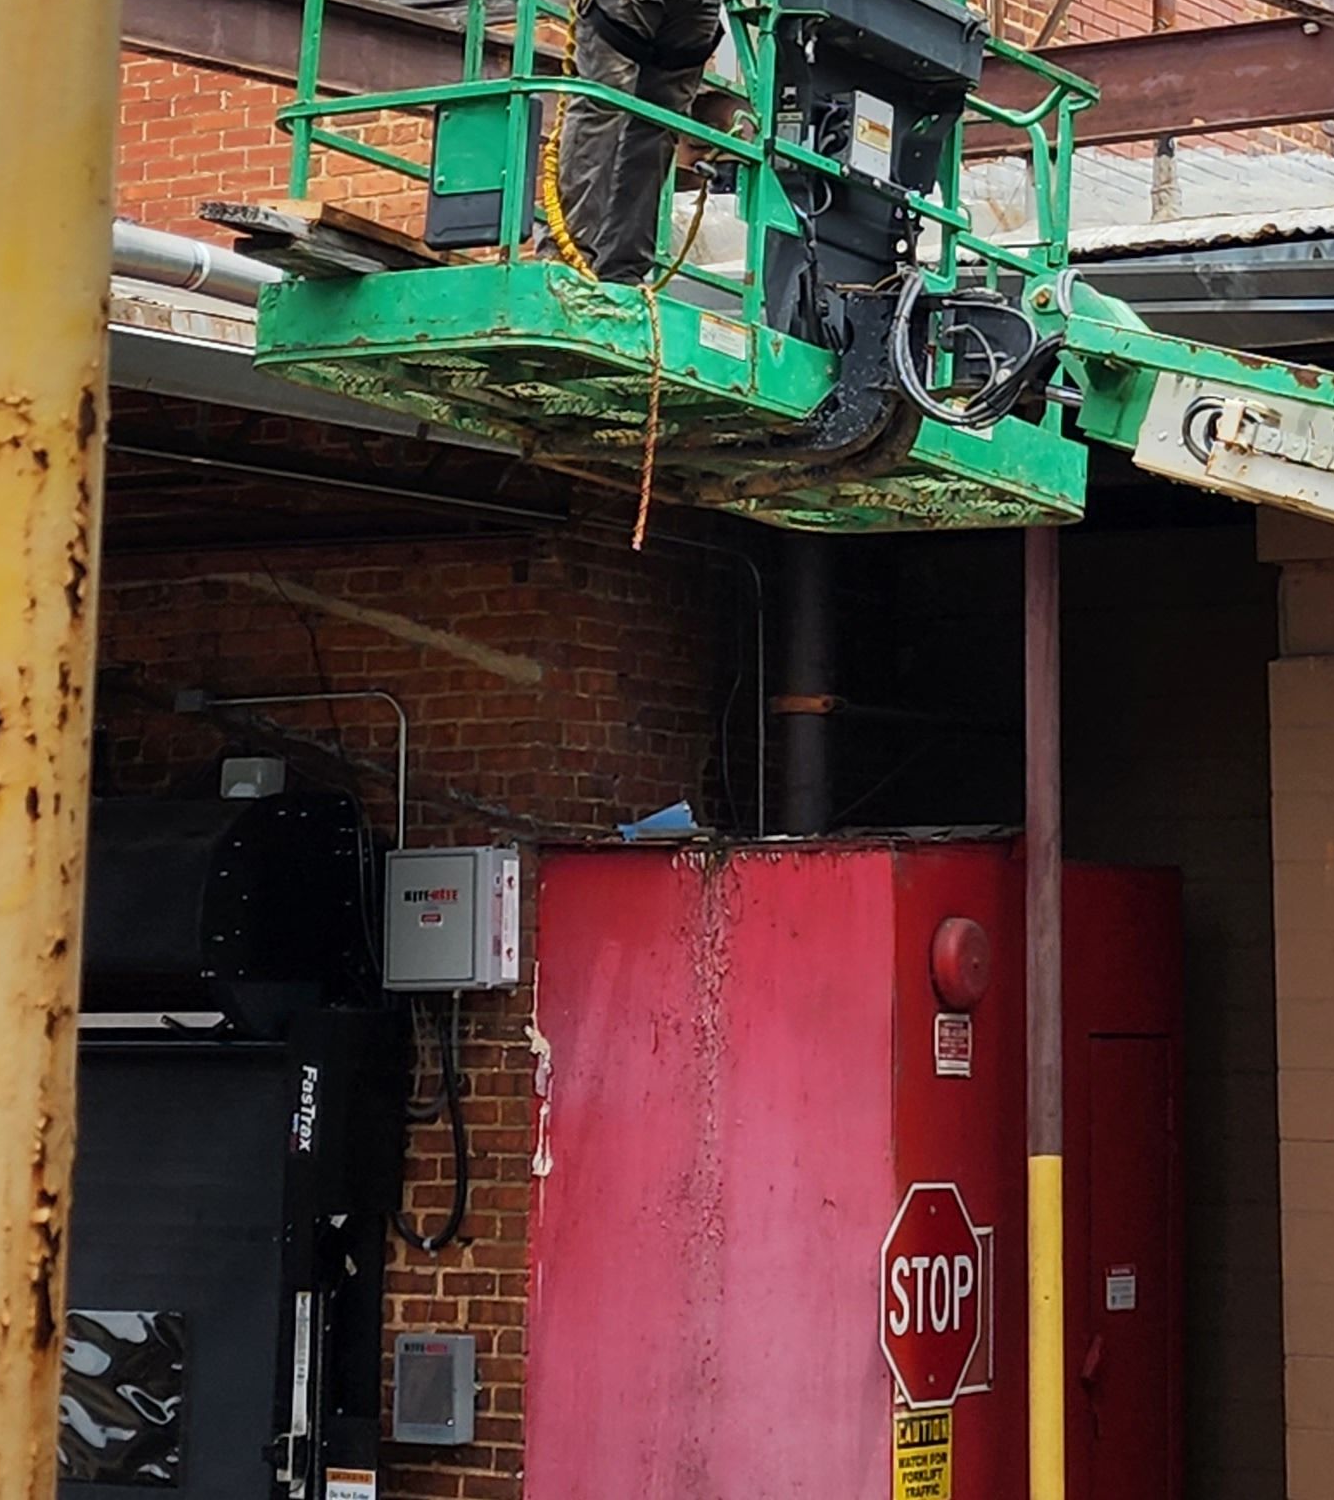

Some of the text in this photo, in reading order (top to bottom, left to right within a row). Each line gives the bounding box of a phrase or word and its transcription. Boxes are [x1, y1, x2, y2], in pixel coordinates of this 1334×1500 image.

[298, 1064, 318, 1153] FasTrax
[889, 1255, 974, 1336] STOP
[898, 1417, 949, 1445] CAUTION
[898, 1451, 948, 1468] WATCH FOR
[902, 1467, 943, 1484] FORKLIFT
[905, 1483, 940, 1498] TRAFFIC
